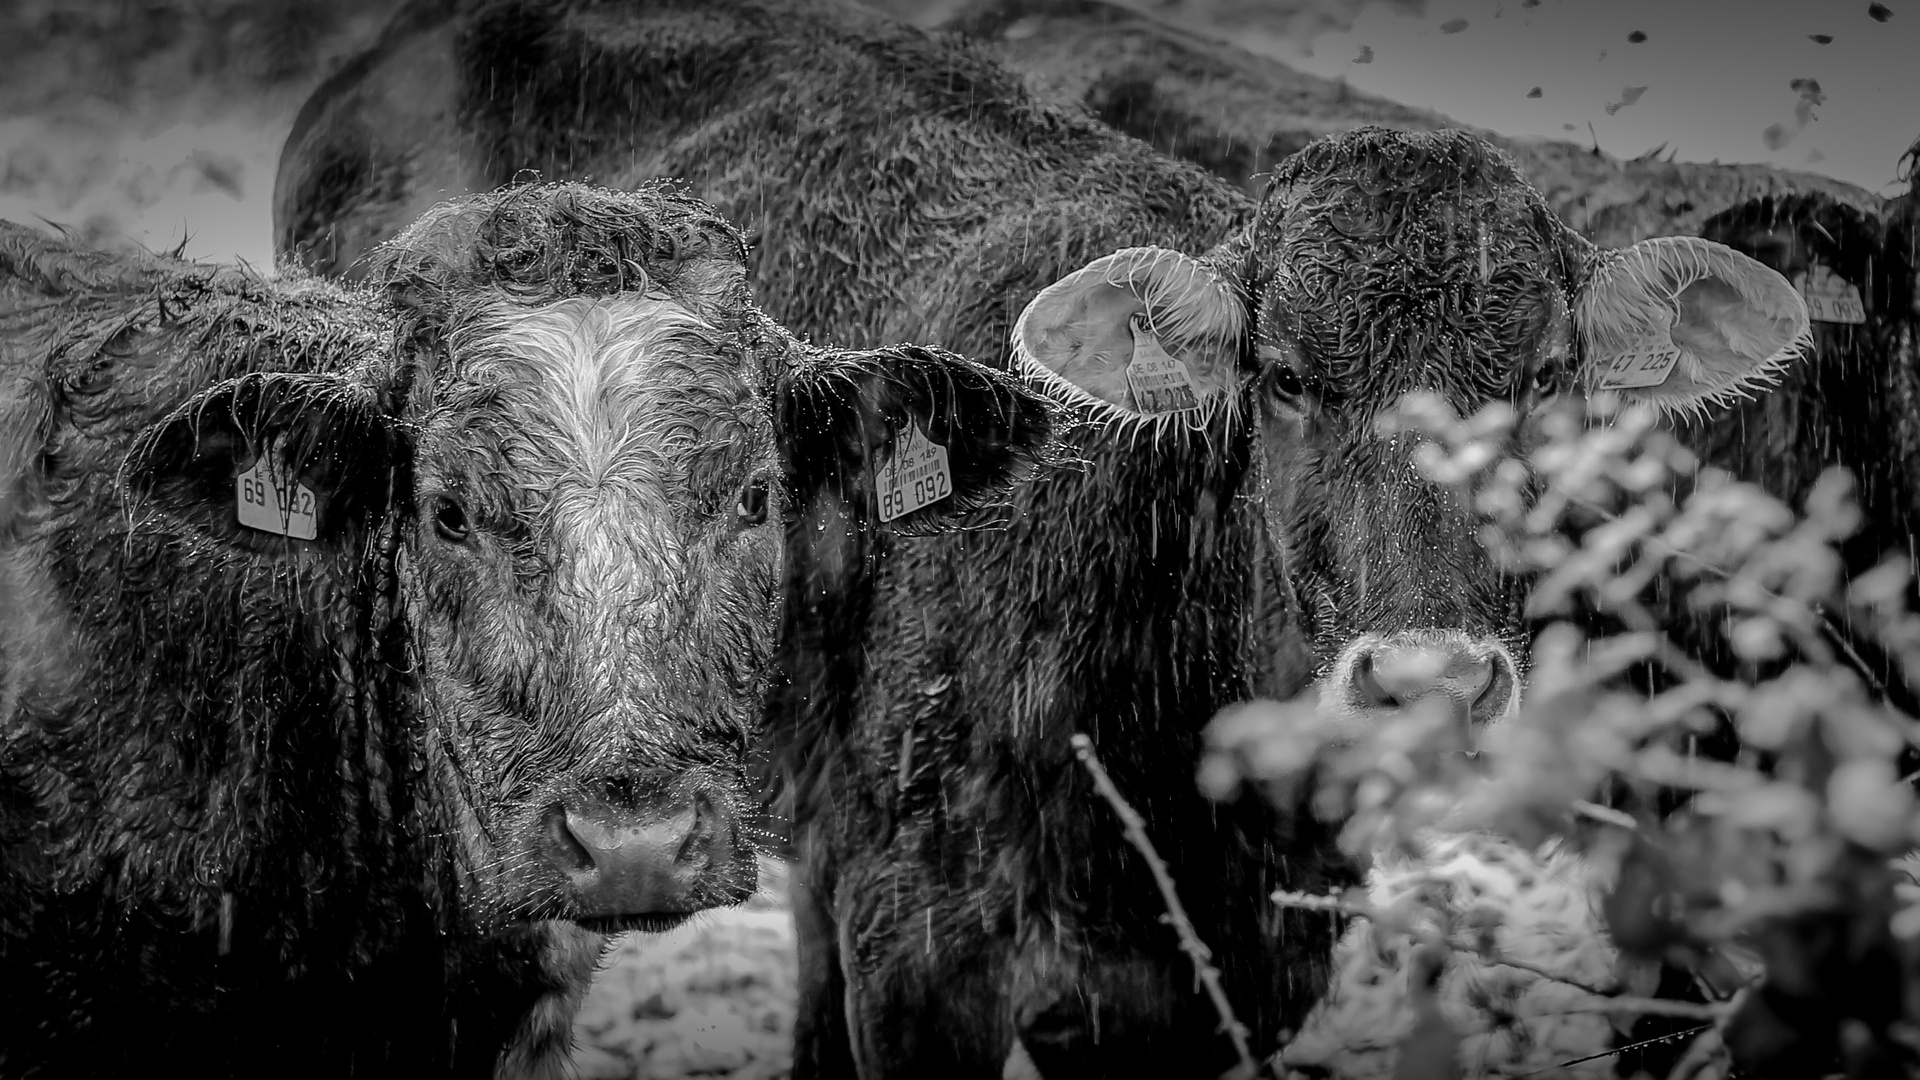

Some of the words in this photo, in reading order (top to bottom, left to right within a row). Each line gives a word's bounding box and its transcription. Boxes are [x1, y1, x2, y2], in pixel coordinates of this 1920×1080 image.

[1132, 363, 1145, 374] DE
[1147, 362, 1159, 373] 08
[1611, 354, 1637, 373] 47
[1639, 351, 1675, 371] 225
[244, 477, 265, 507] 69
[915, 470, 949, 507] 092
